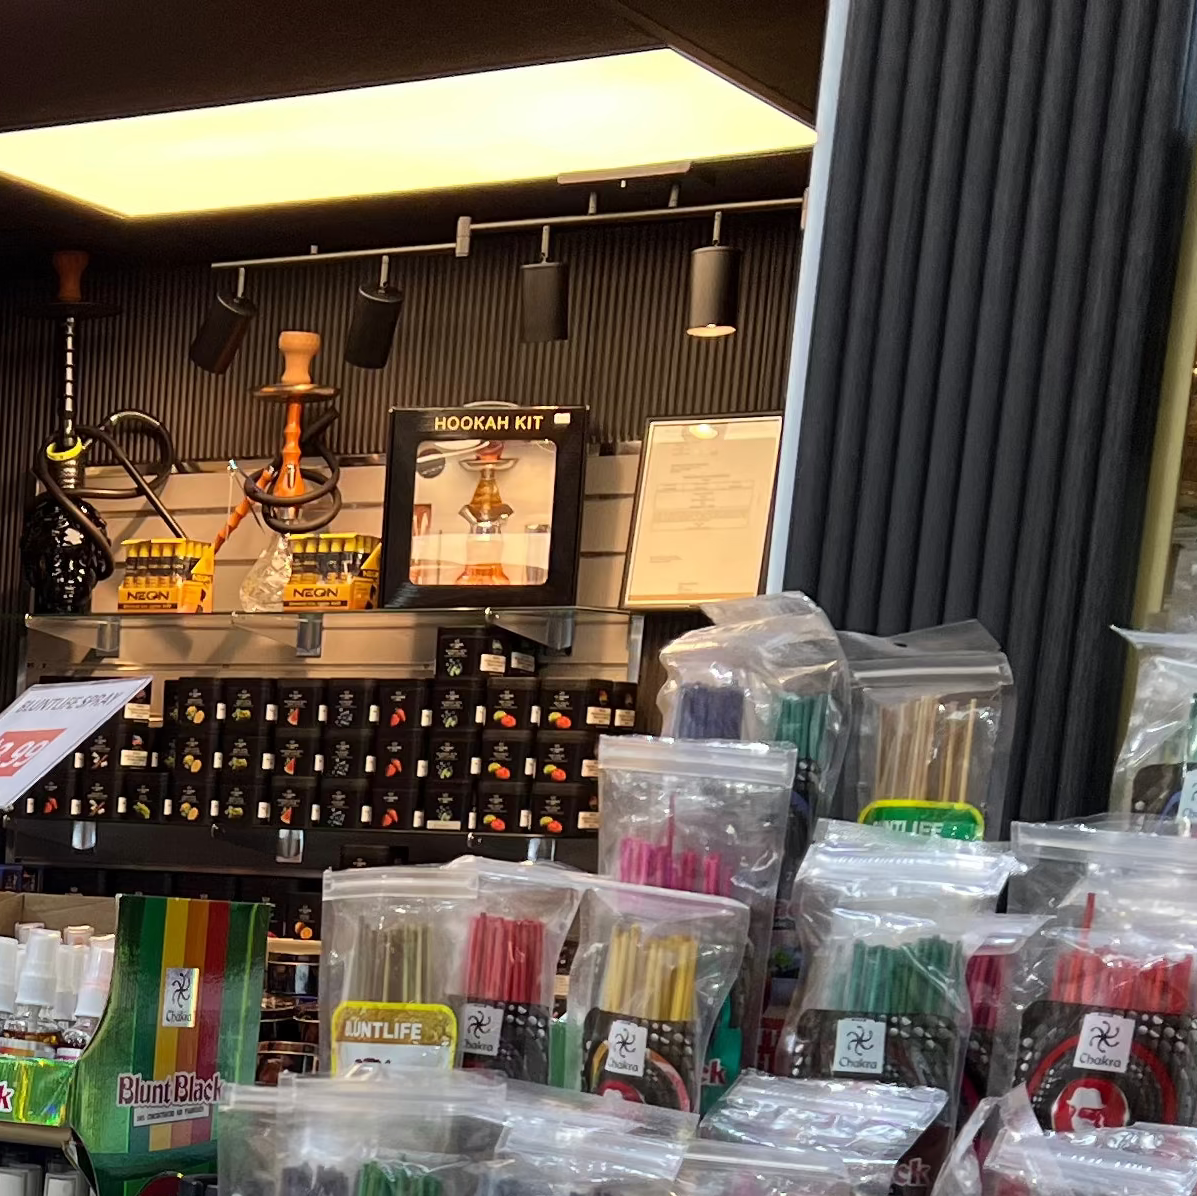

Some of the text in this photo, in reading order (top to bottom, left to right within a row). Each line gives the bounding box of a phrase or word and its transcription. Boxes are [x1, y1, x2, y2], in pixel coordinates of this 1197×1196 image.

[434, 415, 544, 431] HOOKAH KIT
[126, 591, 170, 601] NEON
[293, 587, 339, 598] NEON
[74, 691, 124, 709] SPRAY
[838, 1056, 877, 1070] Chakra
[1079, 1052, 1122, 1069] Chakra
[118, 1073, 223, 1106] Blunt Black
